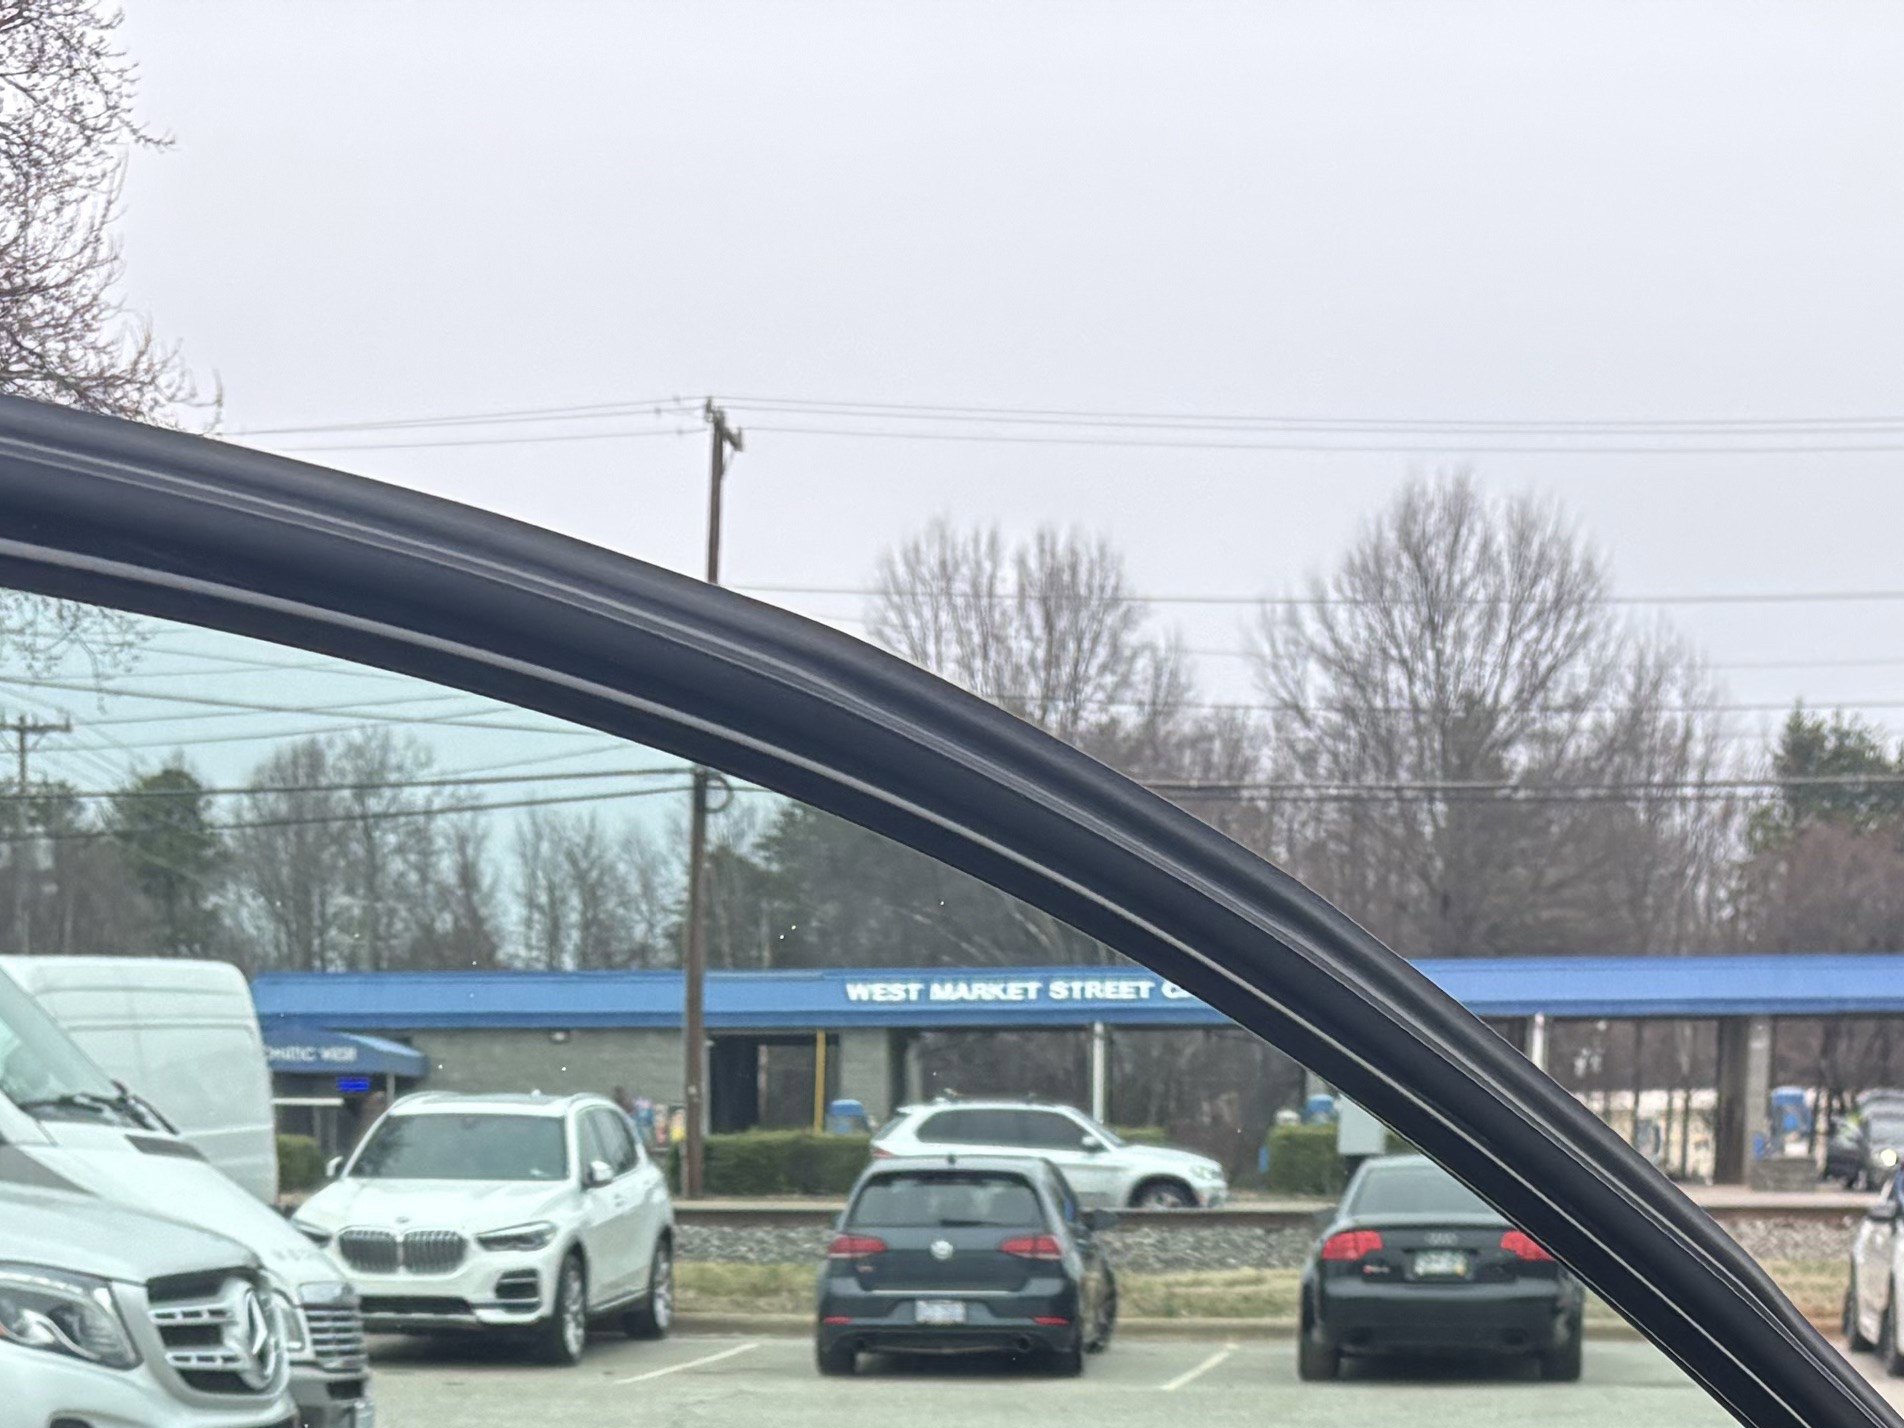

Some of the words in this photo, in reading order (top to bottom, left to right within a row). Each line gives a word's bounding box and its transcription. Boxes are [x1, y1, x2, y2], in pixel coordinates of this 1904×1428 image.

[846, 982, 923, 1001] WEST
[930, 981, 1042, 1001] MARKET
[1049, 979, 1155, 1000] STREET
